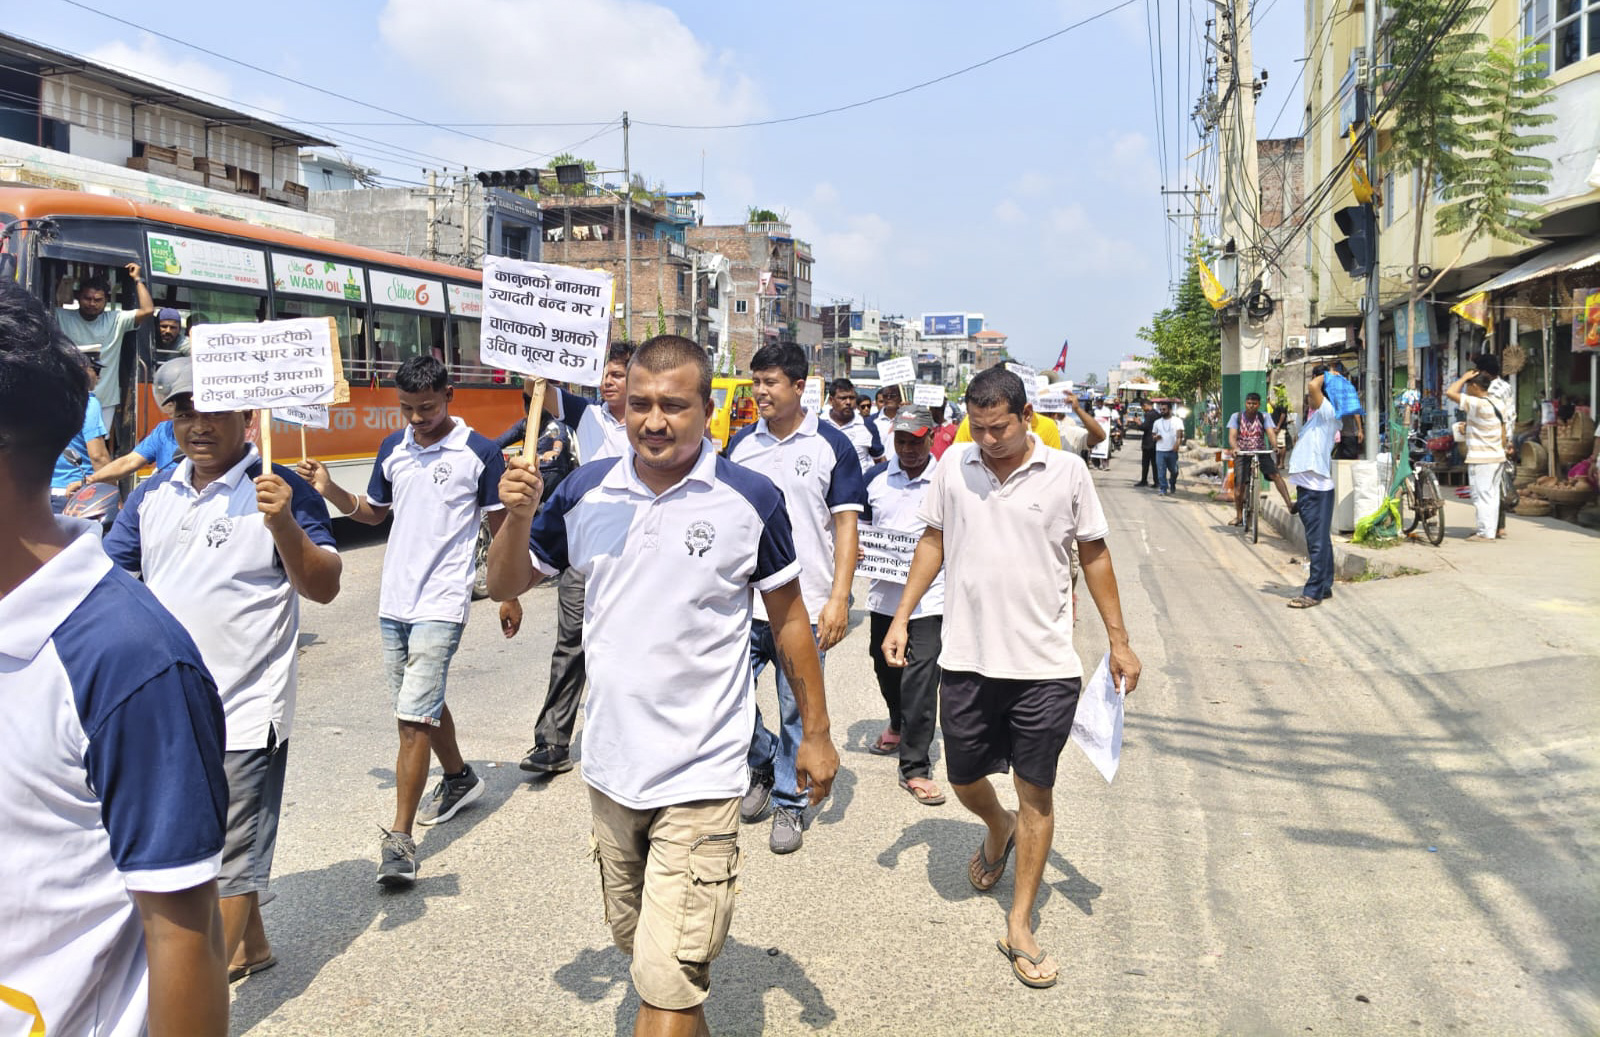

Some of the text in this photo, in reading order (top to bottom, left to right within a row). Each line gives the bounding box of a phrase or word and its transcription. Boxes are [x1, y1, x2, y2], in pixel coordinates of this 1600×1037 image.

[290, 275, 342, 294] WARM OIL
[495, 270, 601, 298] कानुनको नाममा
[489, 288, 534, 306] ज्यादती
[538, 297, 567, 312] बन्द
[572, 302, 594, 317] गर
[207, 328, 312, 349] ट्राफिक प्रहरीको
[490, 316, 599, 348] चालकको श्रमको
[196, 351, 248, 363] व्यवहार
[252, 348, 289, 362] सुधार
[294, 347, 314, 357] गर
[486, 336, 517, 356] उचित
[522, 345, 554, 364] मूल्य
[559, 348, 587, 369] देऊ
[201, 366, 323, 386] चालकलाई अपराधी
[243, 386, 285, 399] श्रमिक
[289, 384, 326, 396] सम्झ
